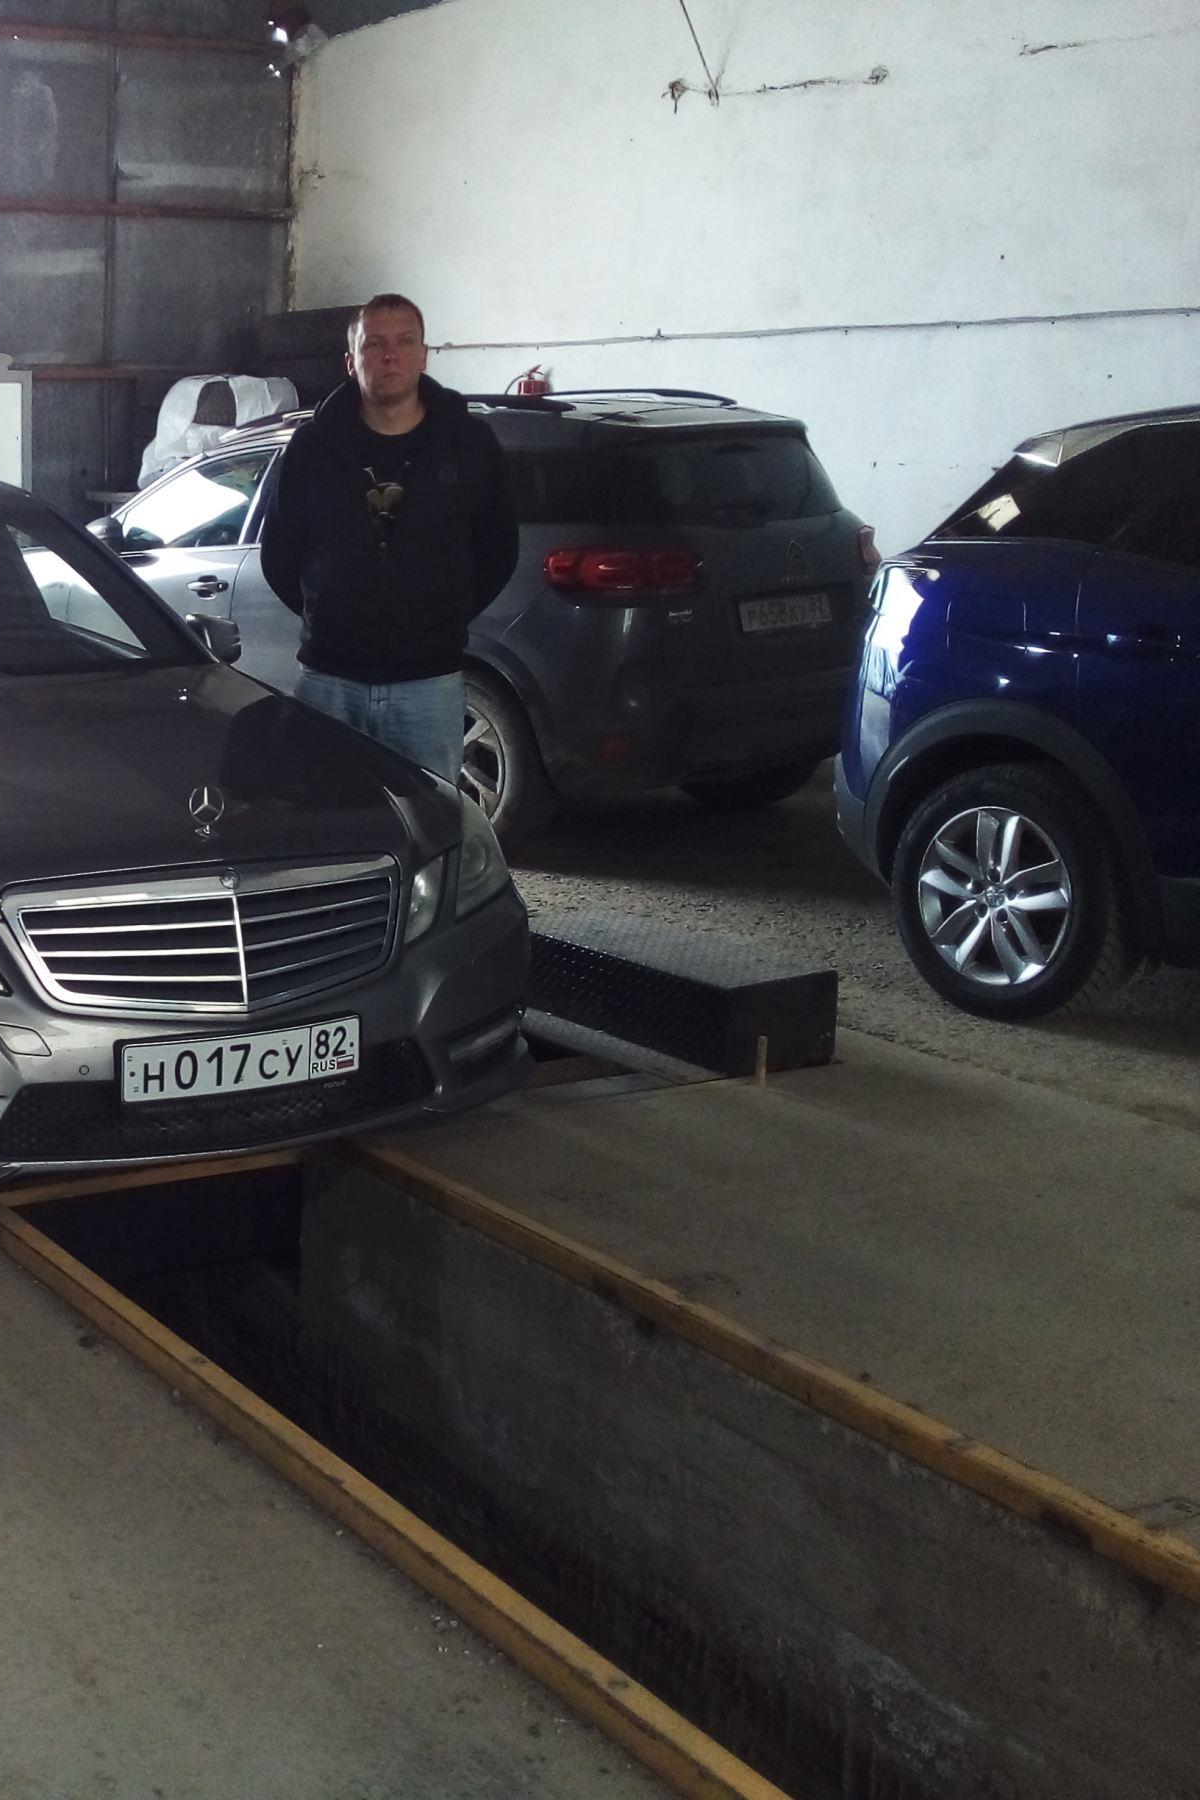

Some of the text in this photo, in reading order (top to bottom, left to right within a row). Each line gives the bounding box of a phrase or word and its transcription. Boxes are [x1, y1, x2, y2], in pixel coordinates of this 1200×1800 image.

[142, 1026, 347, 1094] Н017СУ 82
[311, 1059, 336, 1074] RUS
